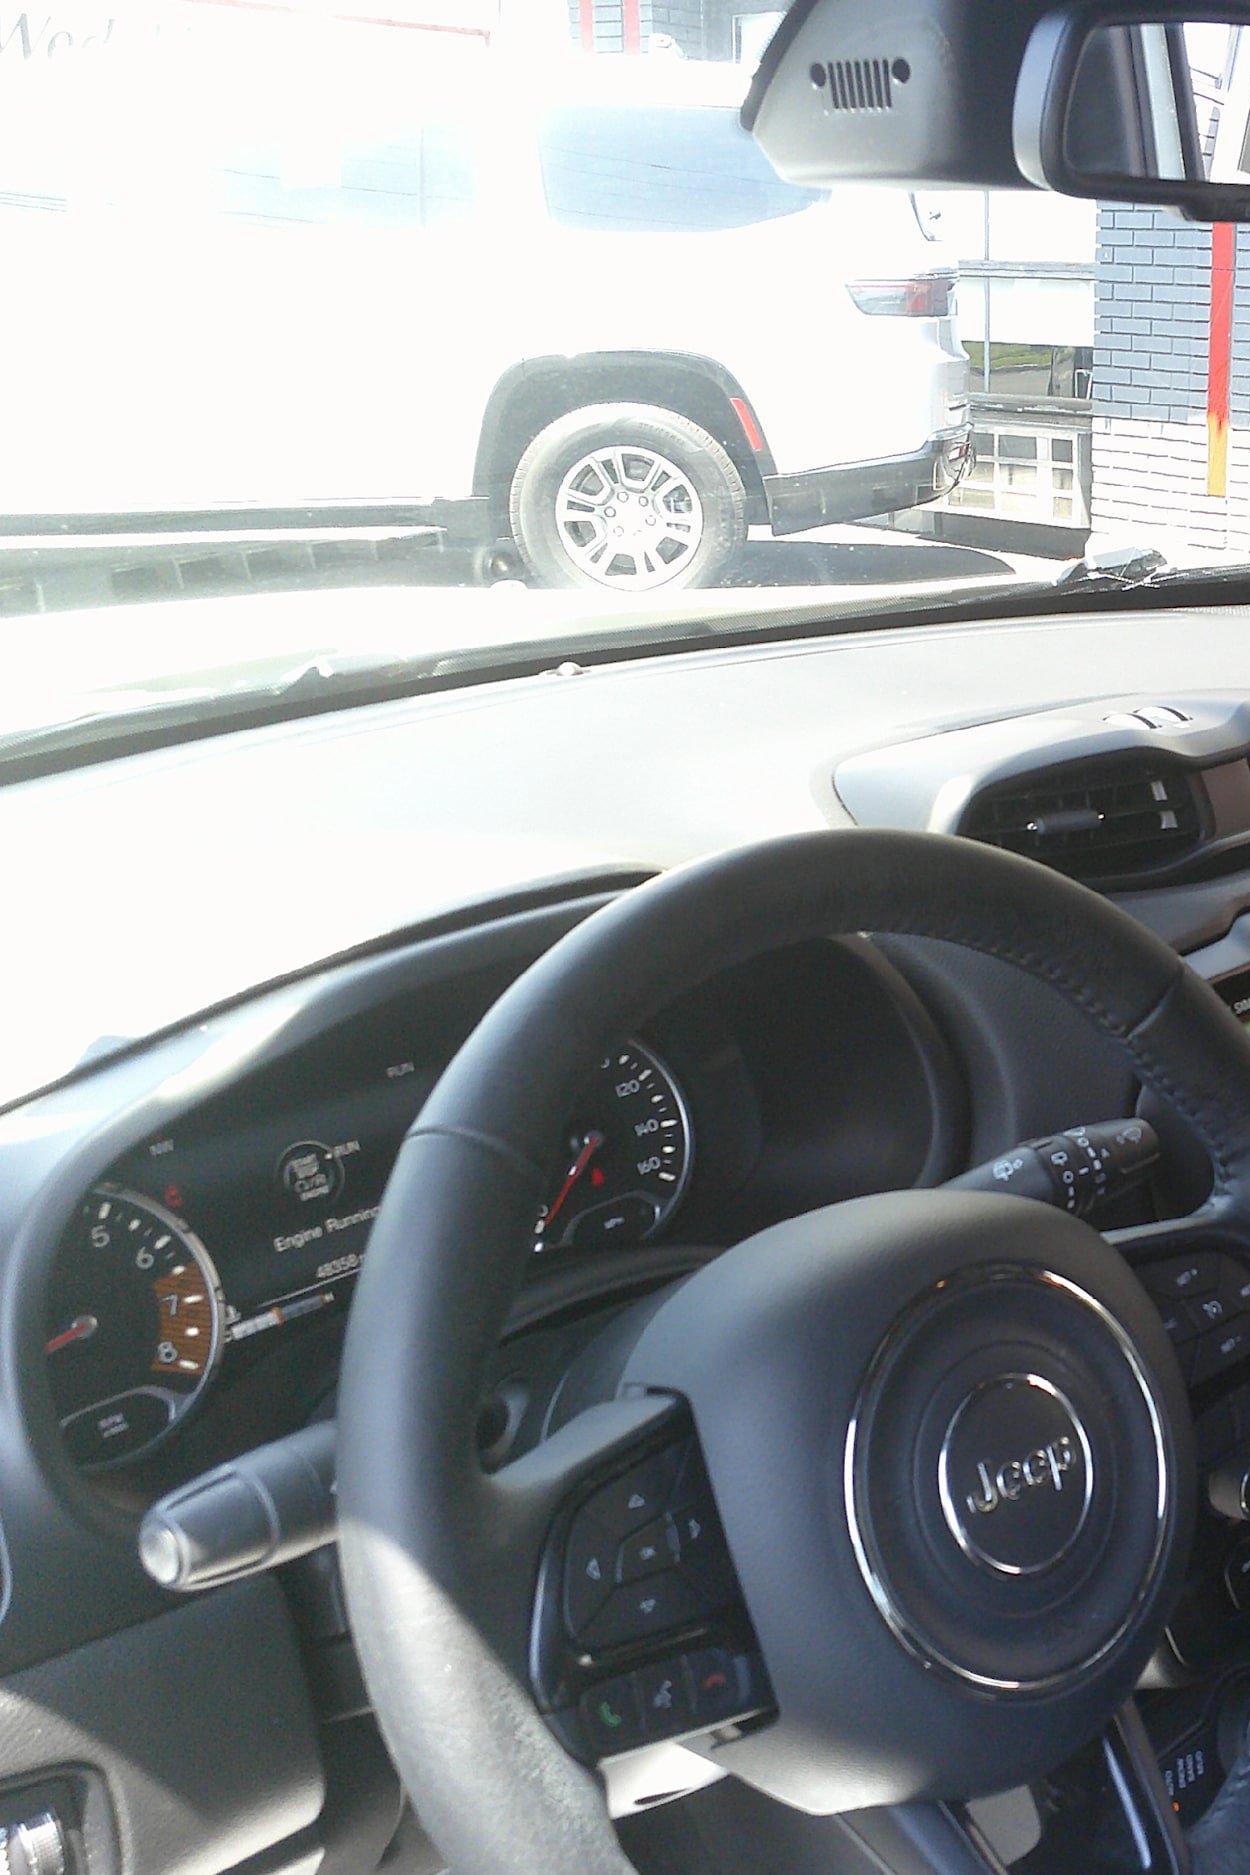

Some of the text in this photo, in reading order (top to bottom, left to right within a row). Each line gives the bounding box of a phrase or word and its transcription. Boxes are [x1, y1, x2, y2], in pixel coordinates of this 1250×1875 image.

[616, 1079, 640, 1097] 120
[634, 1118, 659, 1136] 140
[637, 1156, 661, 1175] 160
[91, 1225, 110, 1248] 5
[273, 1226, 323, 1252] Engine
[135, 1246, 155, 1270] 6
[161, 1294, 178, 1316] 7
[157, 1341, 179, 1364] 8
[965, 1436, 1076, 1514] Jeep
